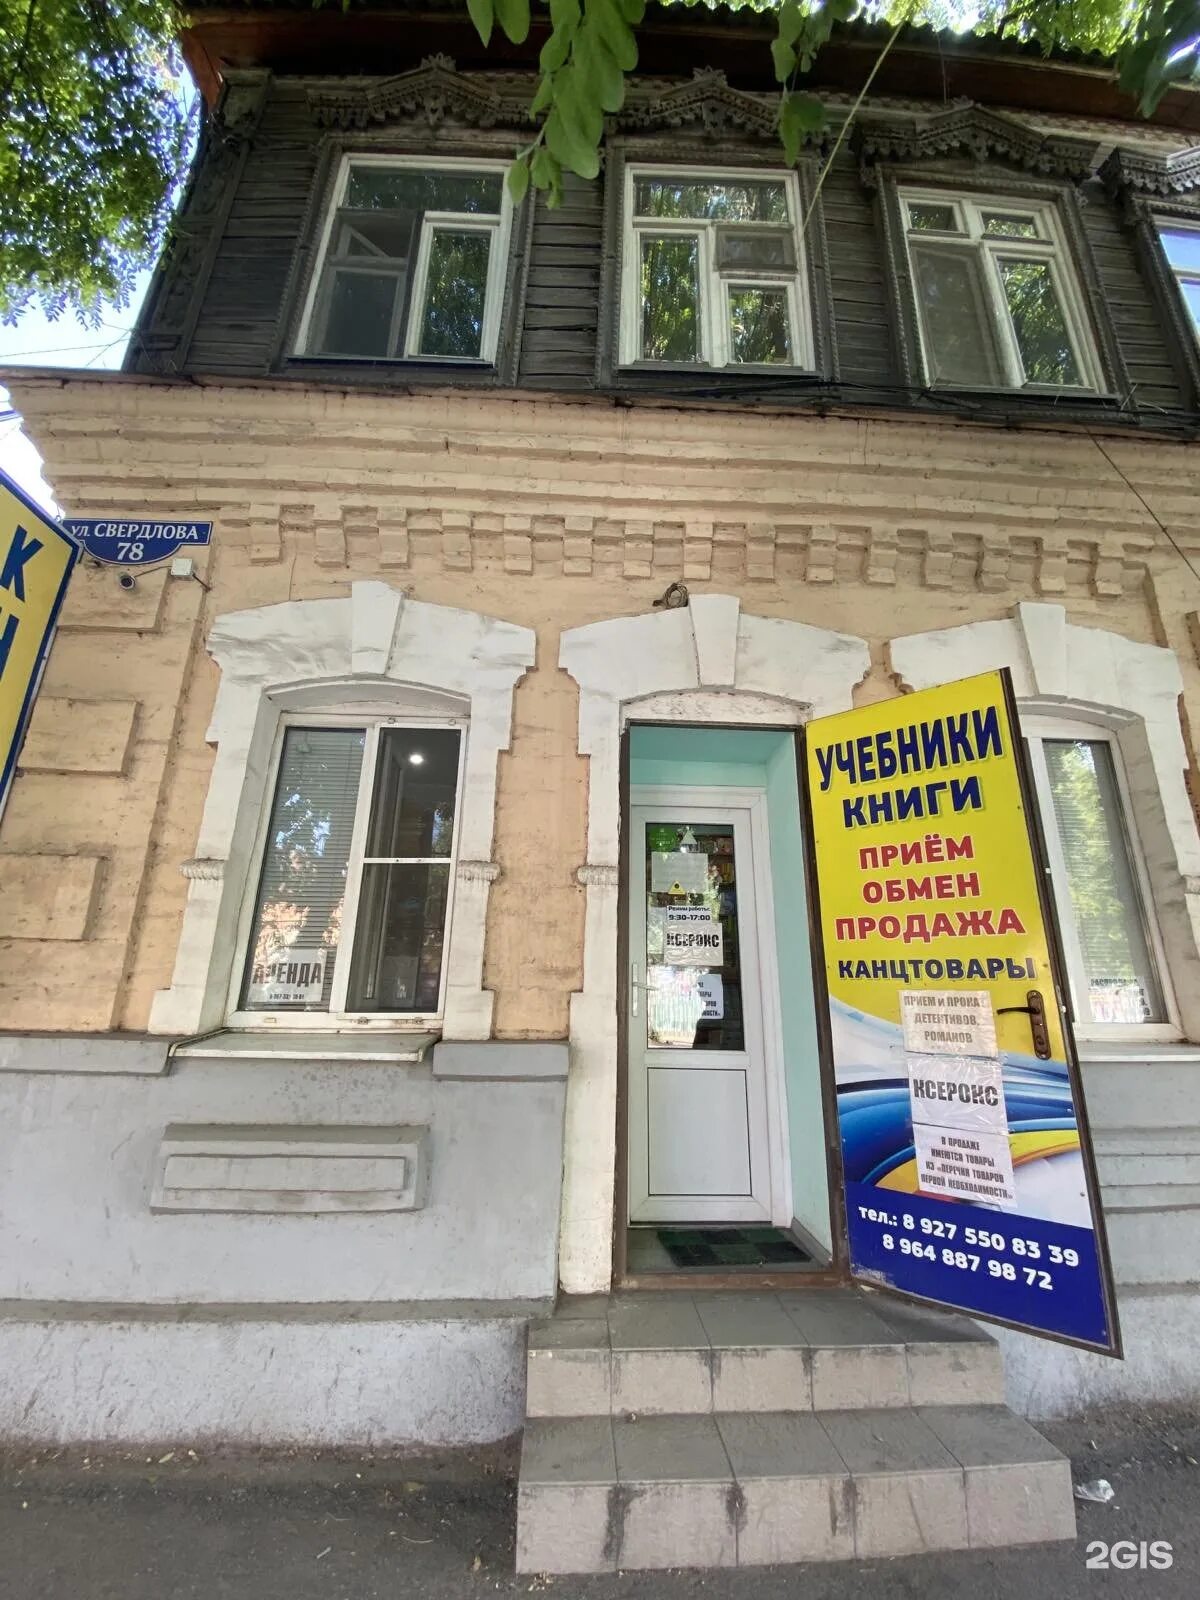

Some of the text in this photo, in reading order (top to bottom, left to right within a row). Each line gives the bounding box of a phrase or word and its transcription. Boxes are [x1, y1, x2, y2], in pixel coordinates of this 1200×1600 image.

[71, 523, 199, 540] ул. СВЕРДЛОВА
[117, 542, 145, 561] 78
[815, 706, 1003, 792] УЧЕБНИКИ
[843, 776, 982, 828] КНИГИ
[859, 834, 974, 870] ПРИЁМ
[862, 872, 980, 904] ОБМЕН
[835, 908, 1026, 944] ПРОДАЖА
[666, 933, 720, 948] КСЕРОКС
[838, 957, 1036, 984] КАНЦТОВАРЫ
[904, 995, 937, 1007] ПРИЕМ
[947, 996, 985, 1008] ПРОКА
[924, 1031, 973, 1043] РОМАНОВ
[913, 1078, 999, 1107] КСЕРОКС
[948, 1137, 980, 1151] ПРОДАЖЕ
[931, 1148, 995, 1168] ИМЕЮТСЯ ТОВАРЫ
[921, 1173, 947, 1187] ПЕРВОЙ
[858, 1206, 1079, 1267] тел.: 8 927 550 83 39
[882, 1233, 1053, 1290] 8 964 887 98 72
